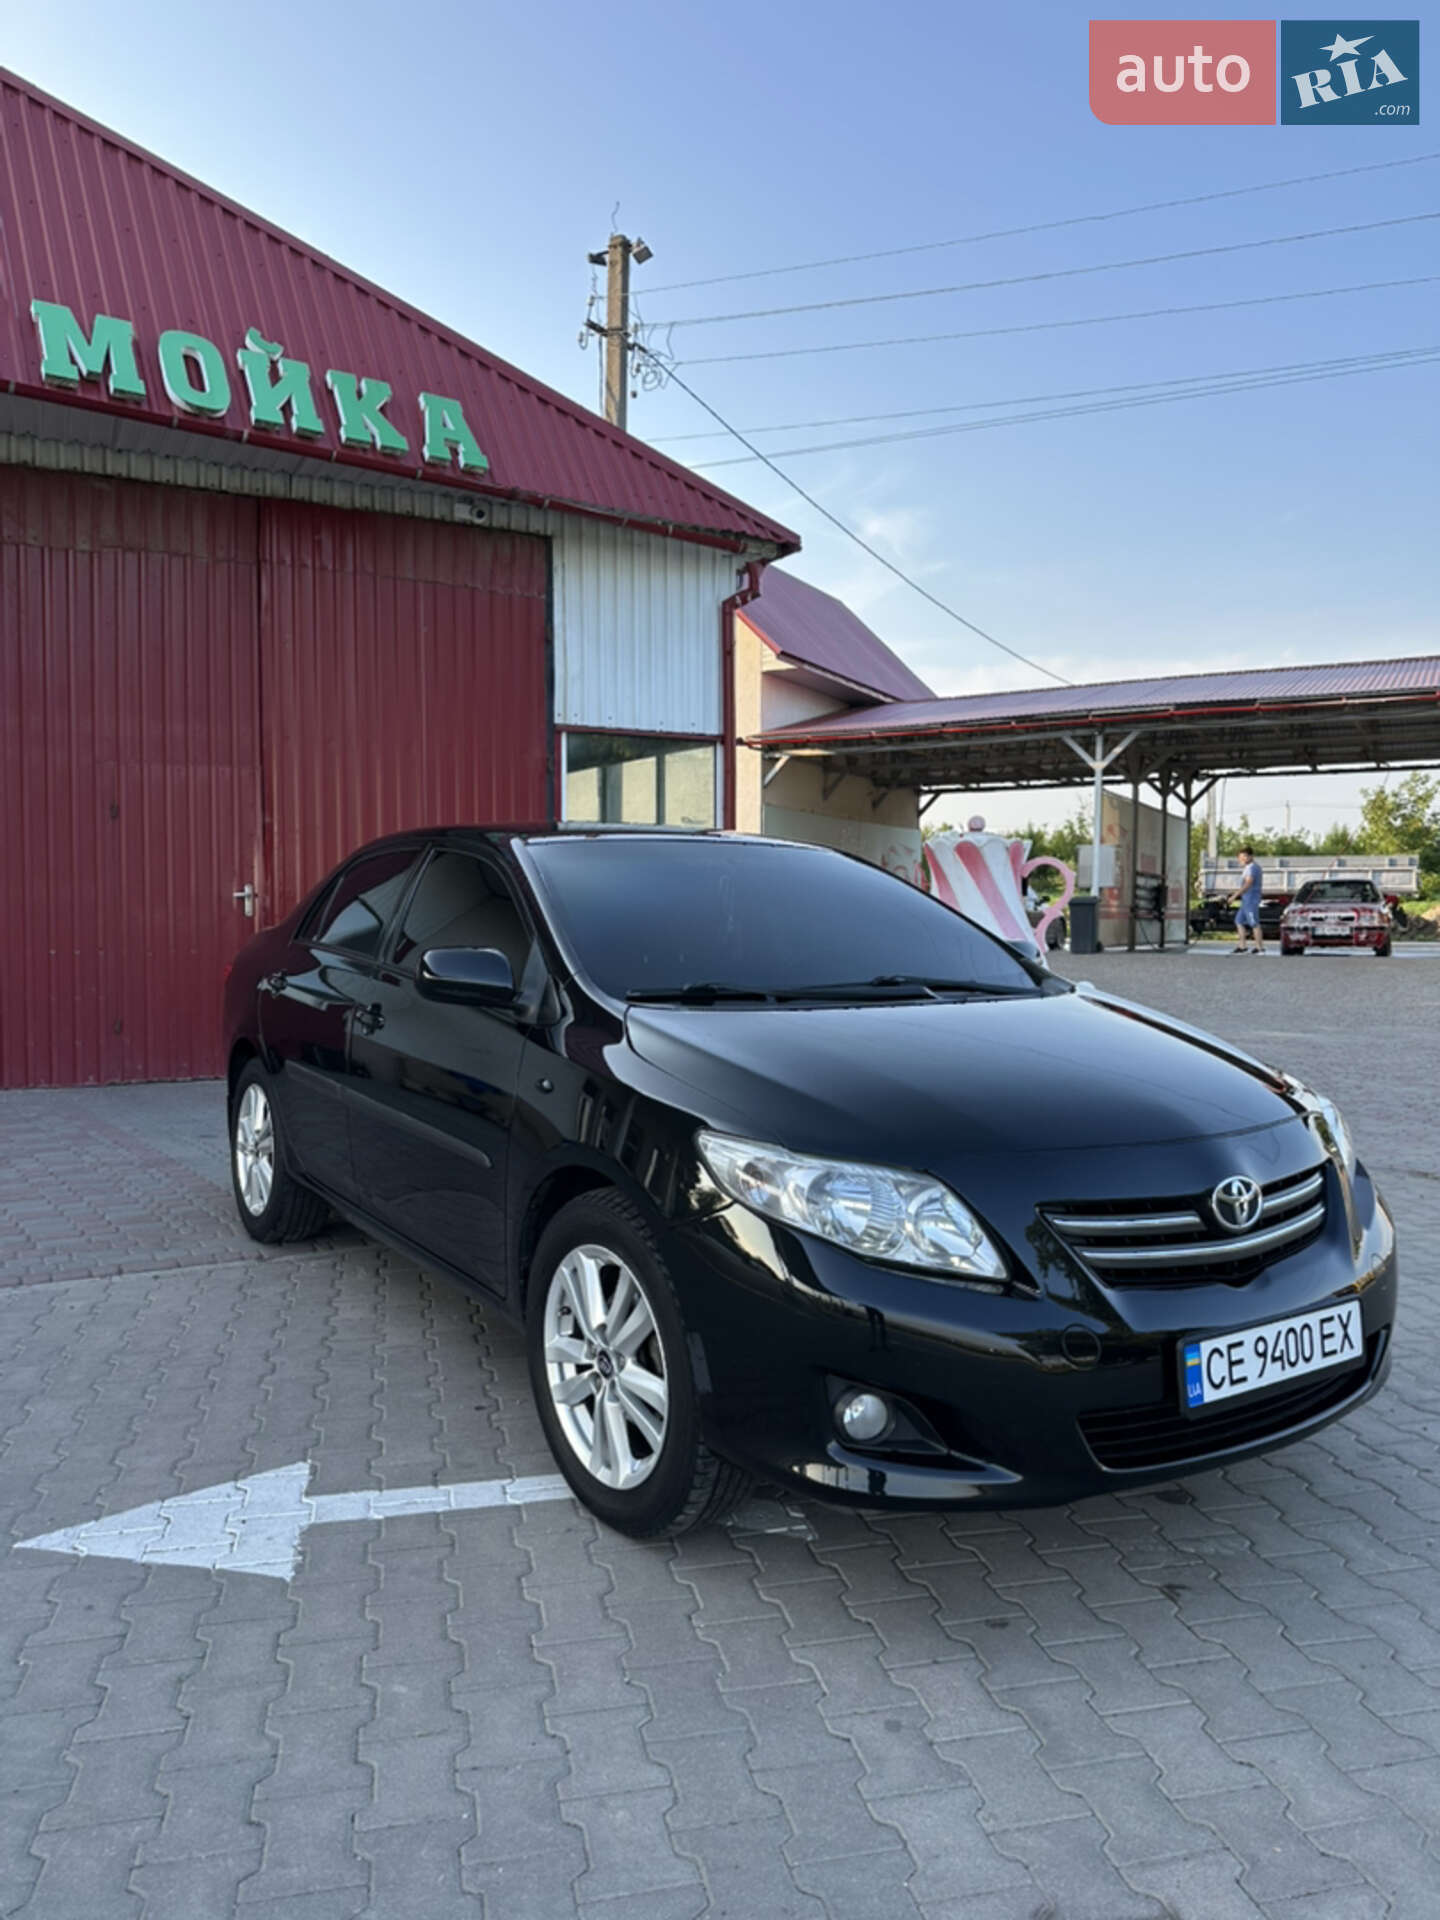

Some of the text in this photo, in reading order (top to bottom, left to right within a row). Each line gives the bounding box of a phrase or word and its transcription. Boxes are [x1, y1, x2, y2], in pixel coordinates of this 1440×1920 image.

[31, 299, 490, 474] МОЙКА
[1206, 1309, 1355, 1390] CE 9400 EX
